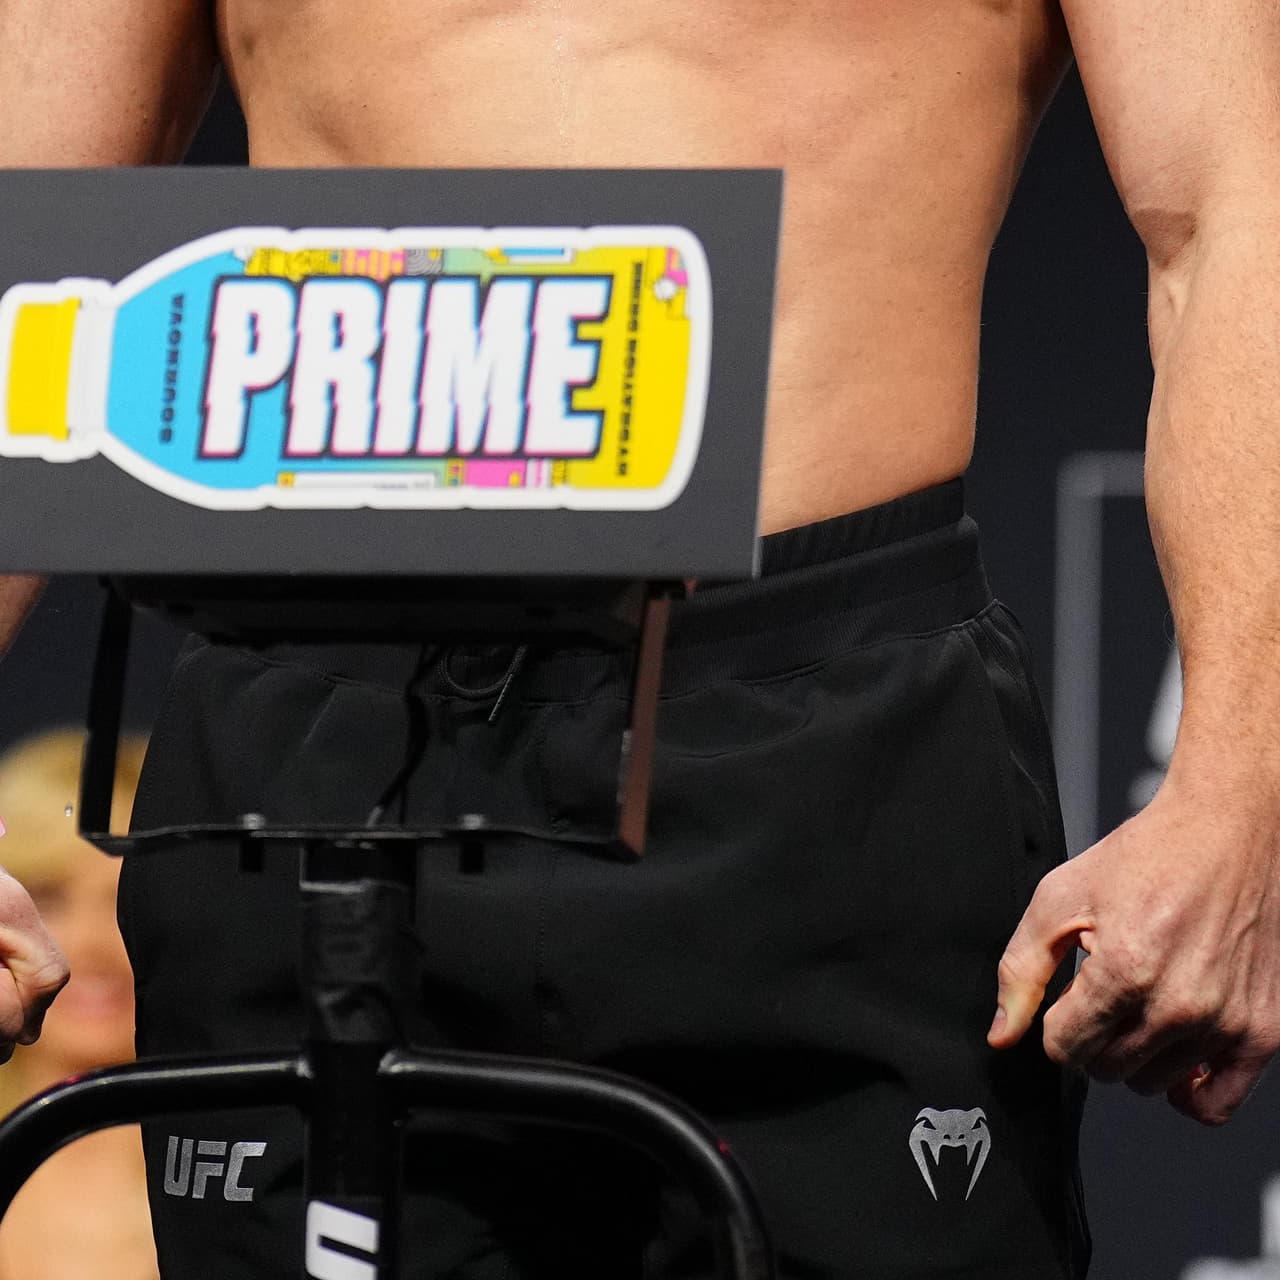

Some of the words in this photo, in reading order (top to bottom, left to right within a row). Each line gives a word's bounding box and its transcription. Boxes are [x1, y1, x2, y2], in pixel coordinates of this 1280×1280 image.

[196, 273, 614, 463] PRIME
[616, 338, 638, 477] HYDRATION
[163, 1135, 268, 1202] UFC
